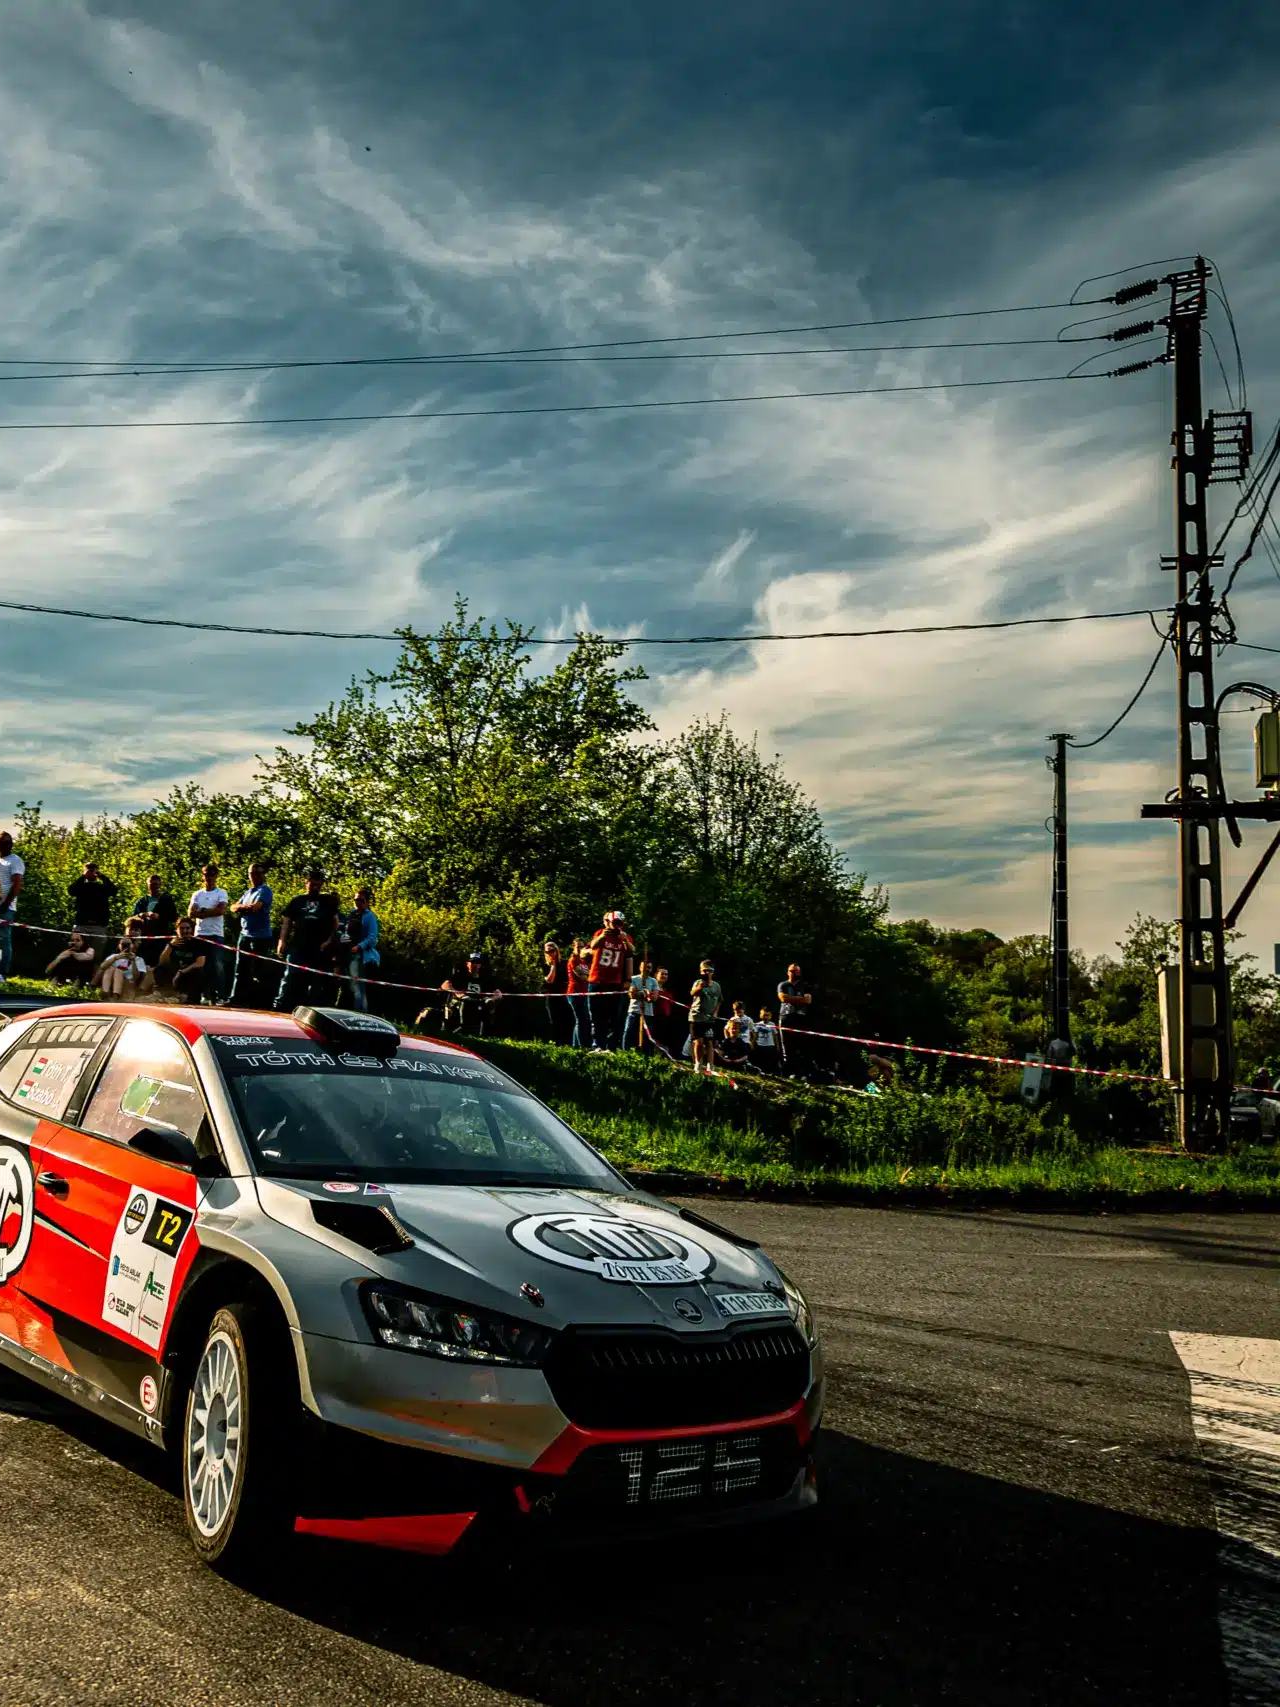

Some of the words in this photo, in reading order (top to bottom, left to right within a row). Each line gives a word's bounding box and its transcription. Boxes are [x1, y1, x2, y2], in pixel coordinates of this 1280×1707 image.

[236, 1050, 336, 1067] TÓTH
[338, 1052, 383, 1068] ÉS
[386, 1058, 443, 1075] FIAI
[442, 1064, 504, 1086] KFT.
[155, 1209, 182, 1246] T2
[602, 1262, 651, 1281] TÓTH
[646, 1262, 672, 1281] ÉS
[721, 1295, 754, 1312] 11R
